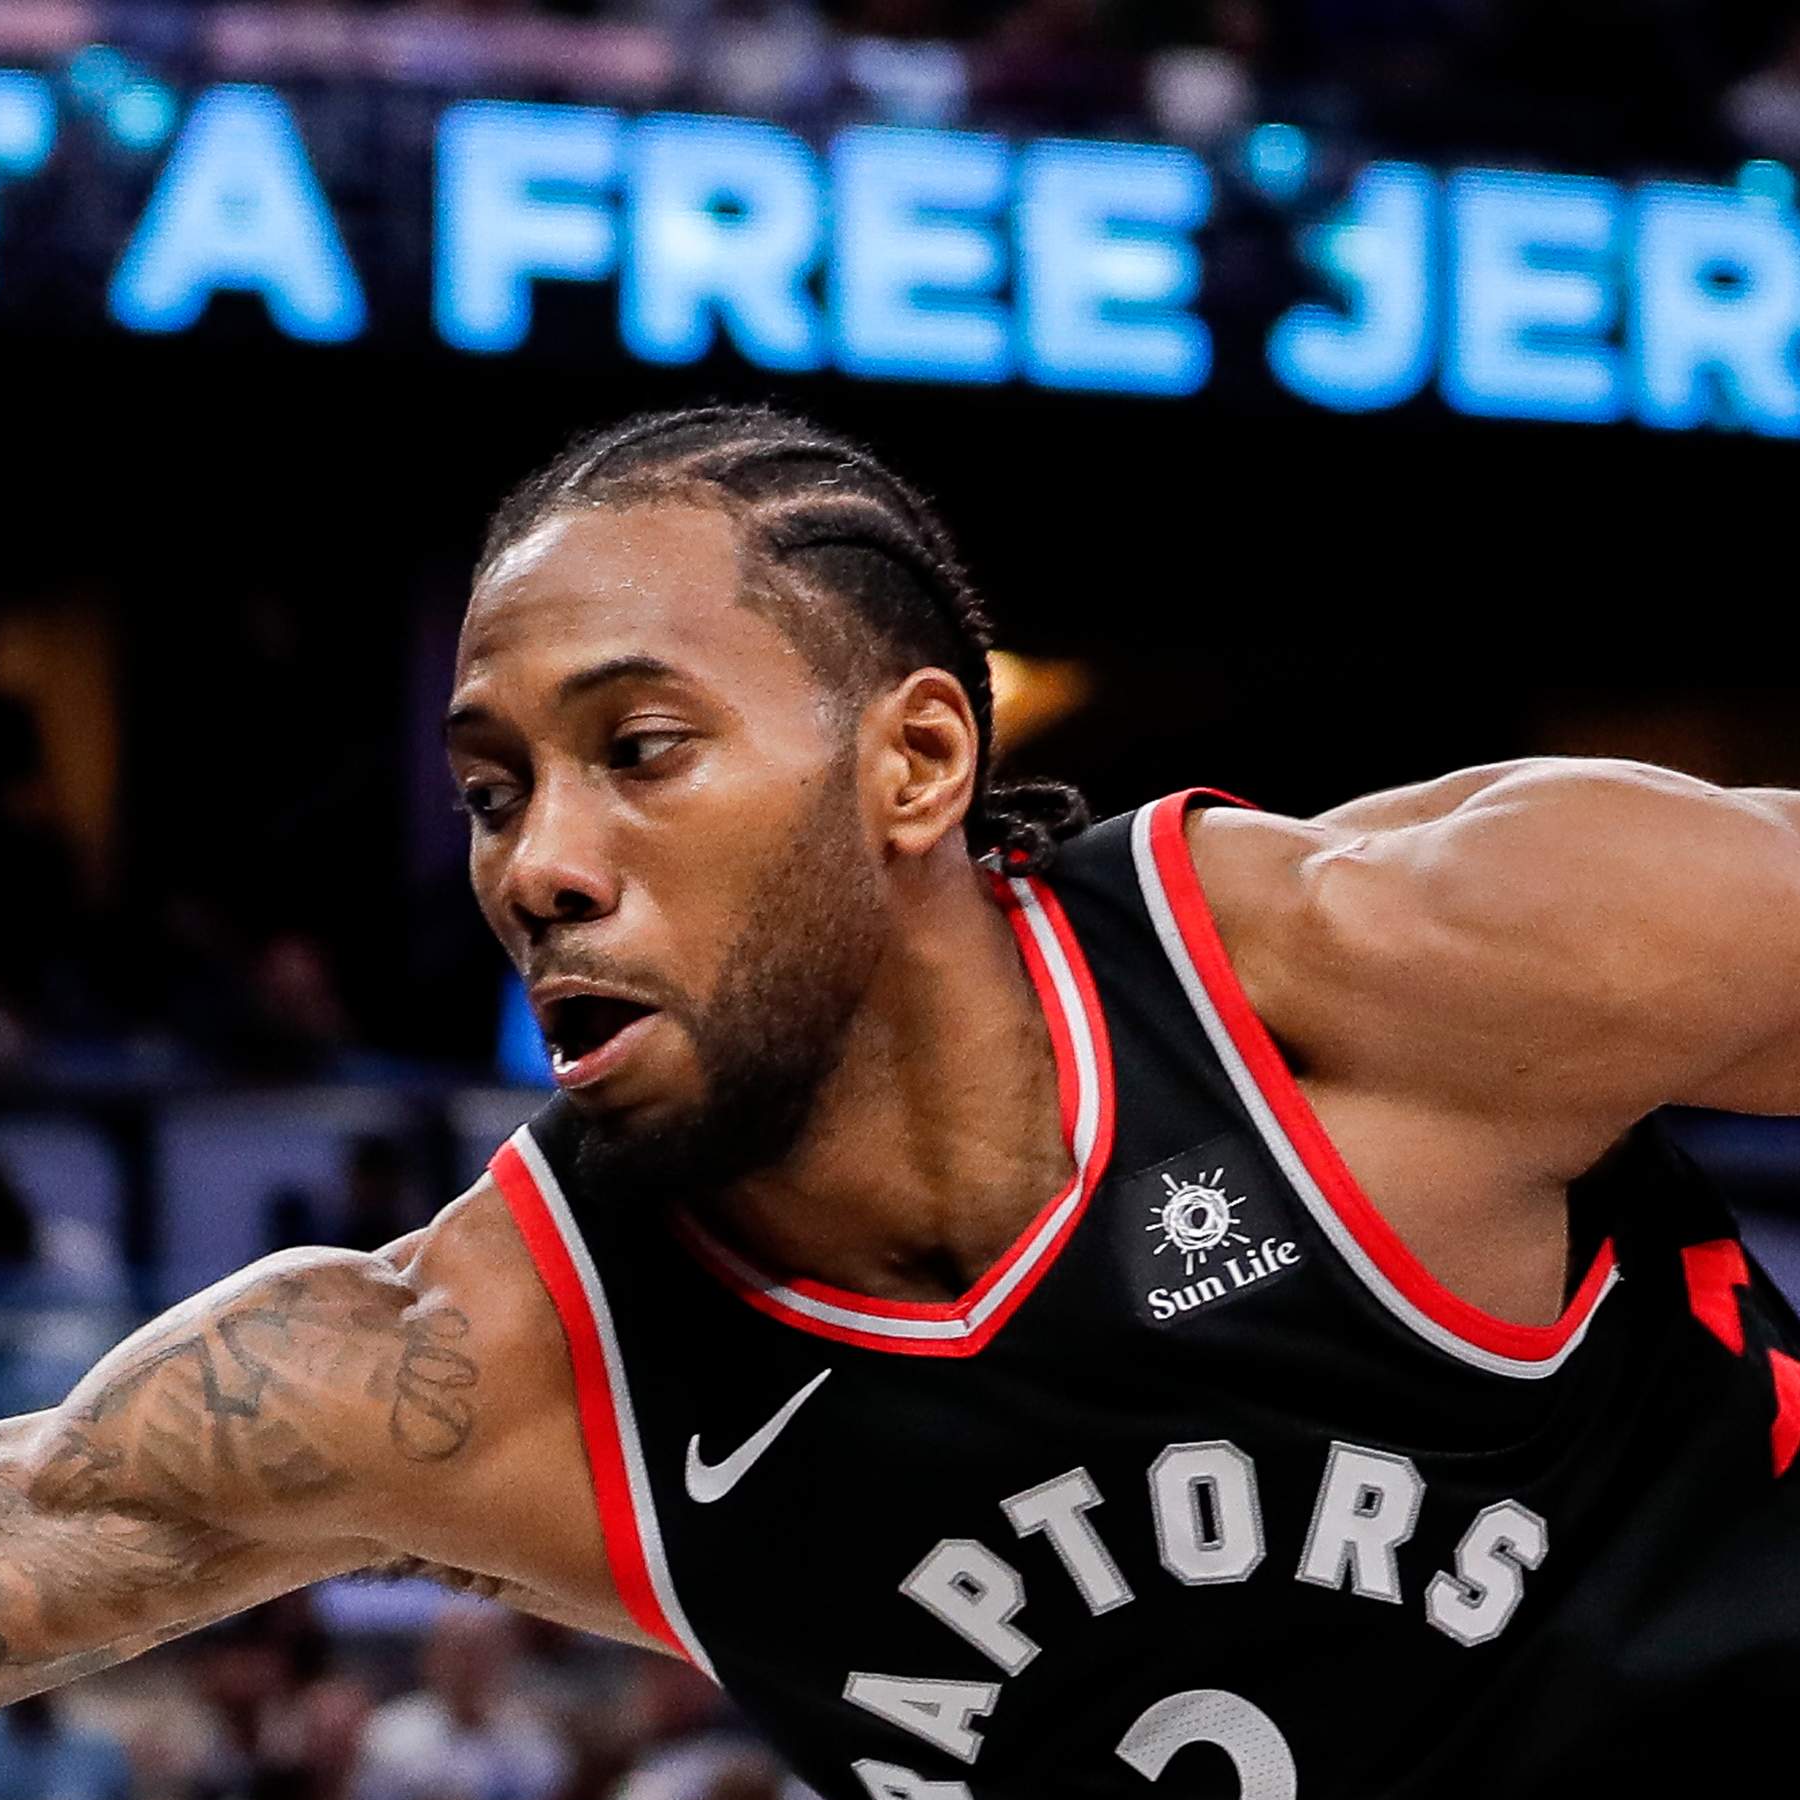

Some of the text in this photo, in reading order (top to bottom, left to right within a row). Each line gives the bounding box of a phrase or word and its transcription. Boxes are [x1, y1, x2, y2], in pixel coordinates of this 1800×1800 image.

[107, 83, 365, 342] A
[433, 99, 1213, 396] FREE
[1147, 1237, 1301, 1320] Sun Life
